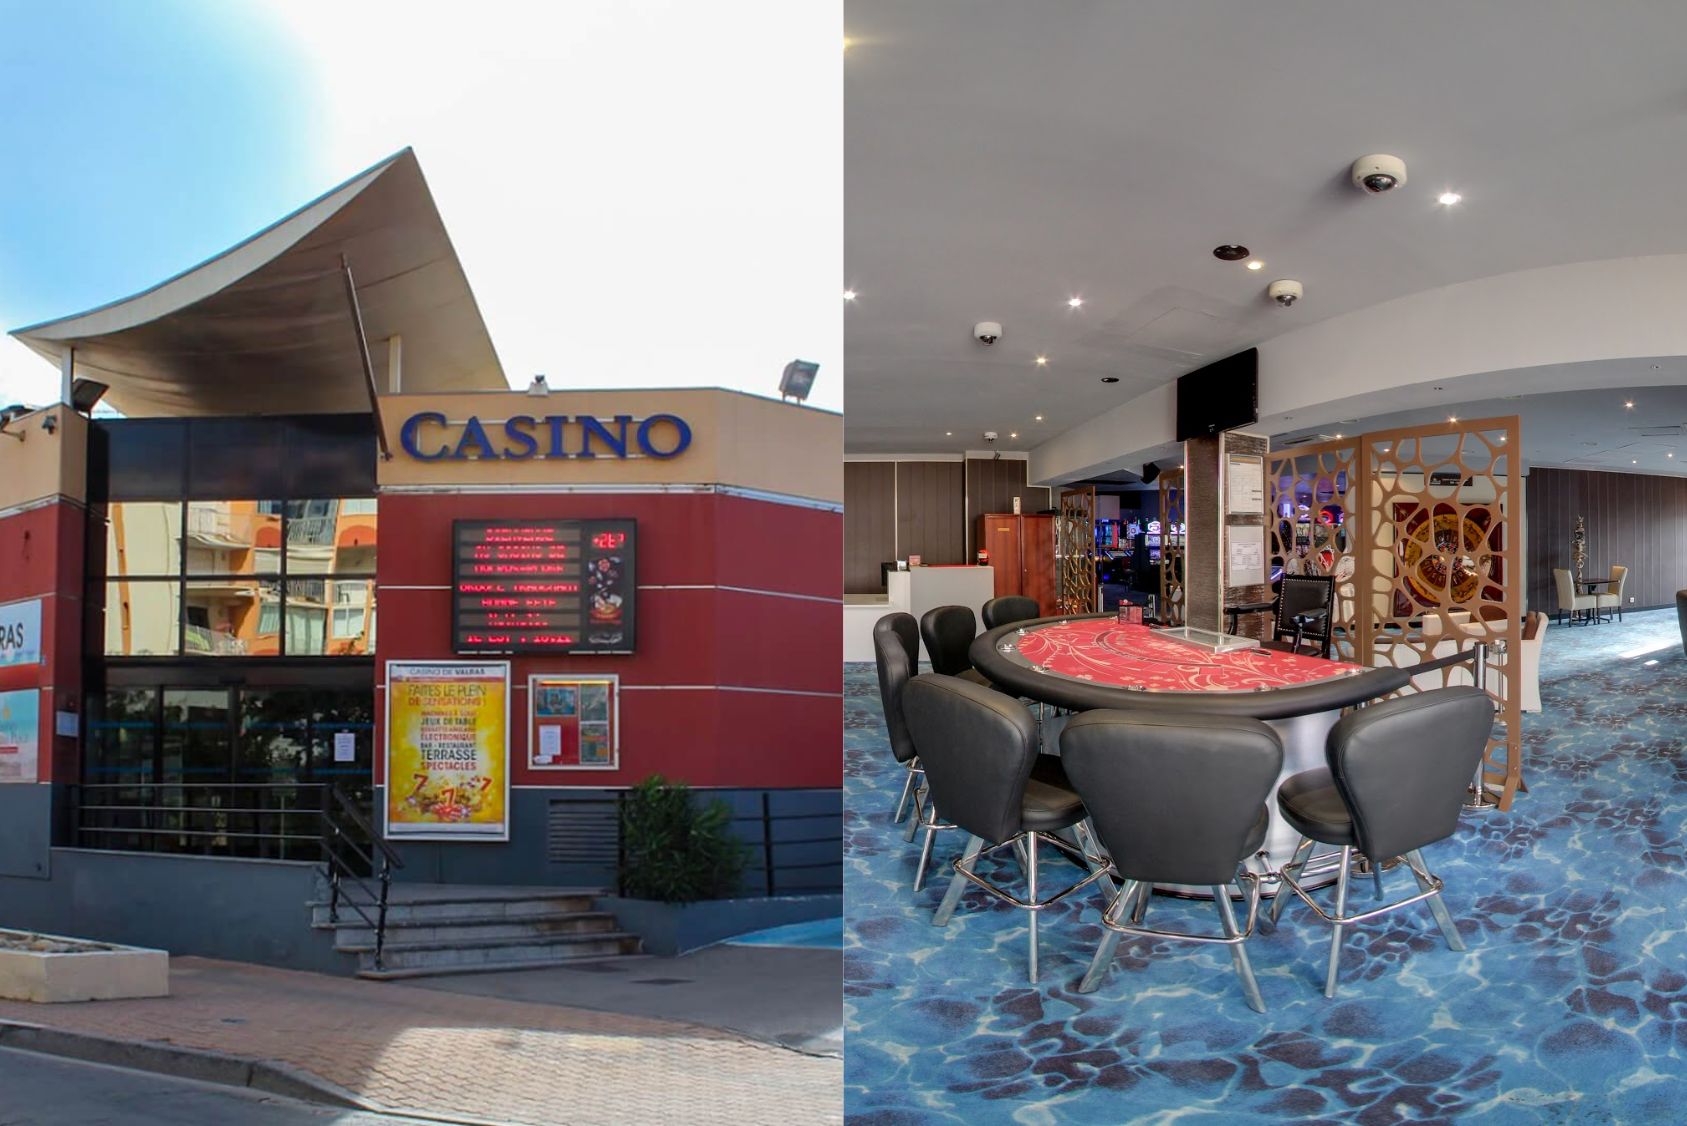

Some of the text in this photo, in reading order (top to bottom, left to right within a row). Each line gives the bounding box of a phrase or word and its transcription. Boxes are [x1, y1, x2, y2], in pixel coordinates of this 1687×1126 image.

[400, 412, 692, 462] CASINO
[408, 683, 487, 697] FAITES LE PLEIN
[408, 696, 421, 706] DE
[421, 717, 477, 725] JEUX DE TABLE
[420, 749, 478, 760] TERRASSE
[420, 762, 477, 770] SPECTACLES
